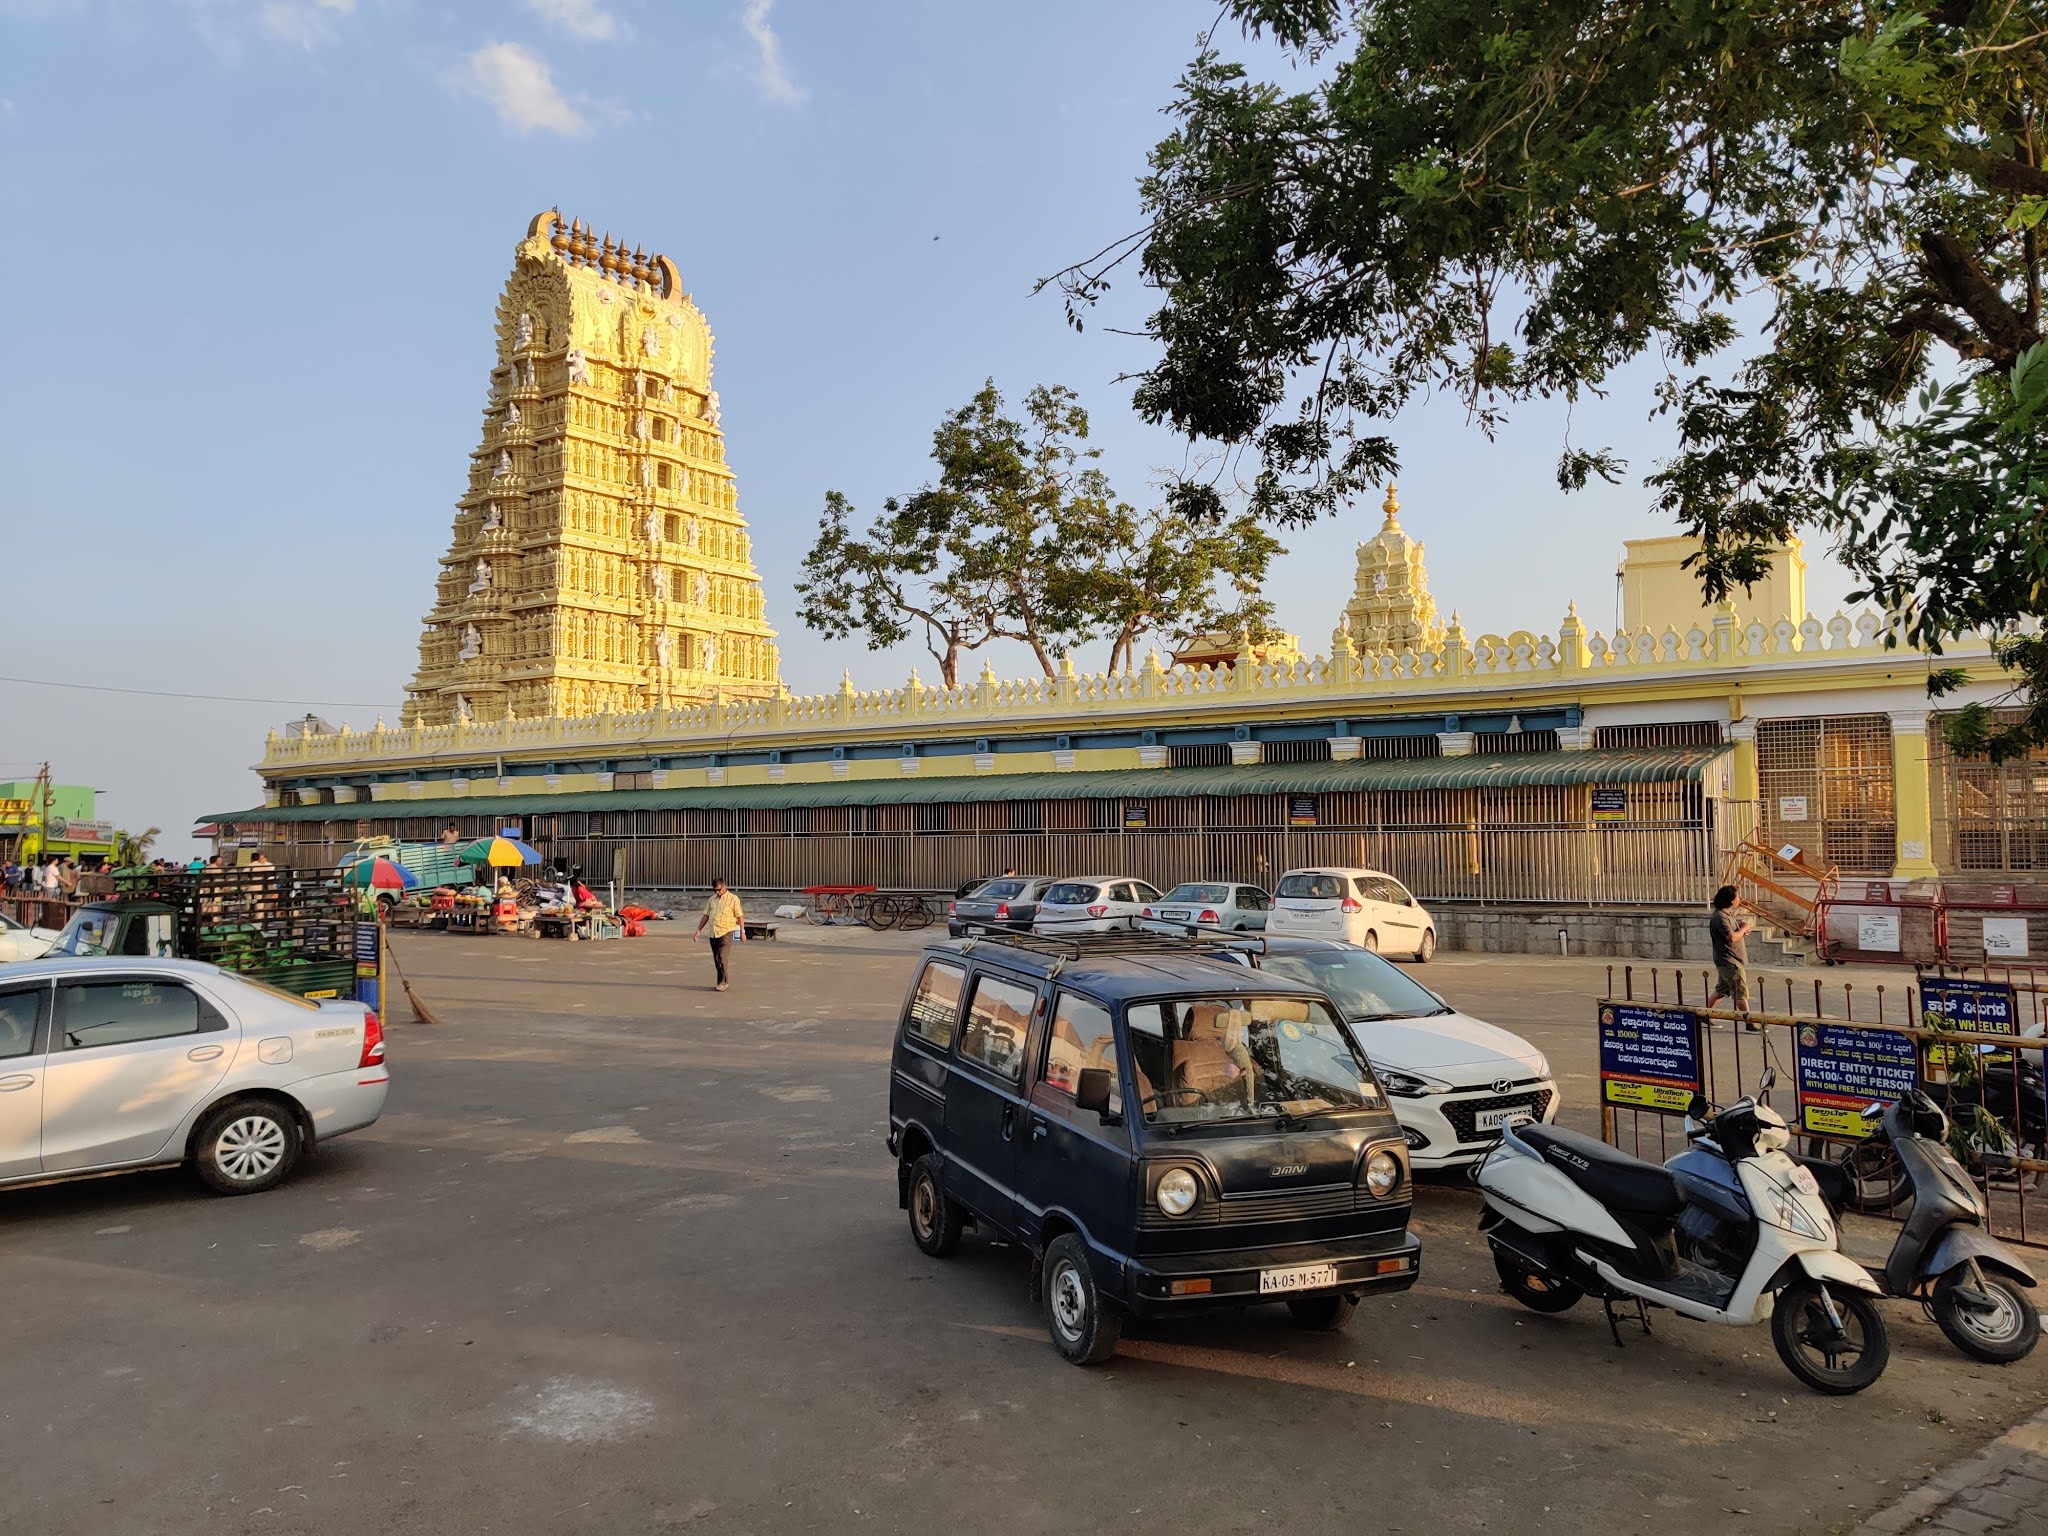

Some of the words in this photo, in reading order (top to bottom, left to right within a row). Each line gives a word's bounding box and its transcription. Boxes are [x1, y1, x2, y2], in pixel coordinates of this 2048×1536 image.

[1664, 1021, 1687, 1031] ವಿನಂತಿ
[1958, 1019, 2011, 1034] WHEELER
[1868, 1040, 1883, 1051] 100/-
[1801, 1057, 1837, 1070] DIRECT
[1840, 1062, 1874, 1075] ENTRY
[1876, 1066, 1915, 1080] TICKET
[1805, 1069, 1843, 1082] Rs.100/-
[1845, 1074, 1867, 1086] ONE
[1870, 1077, 1912, 1091] PERSON
[1653, 1088, 1684, 1097] UltraTech
[1806, 1080, 1822, 1089] WITH
[1824, 1083, 1837, 1091] ONE
[1839, 1085, 1855, 1093] FREE
[1856, 1087, 1878, 1096] LADDU
[1880, 1089, 1902, 1100] PRASA
[1805, 1096, 1868, 1109] www.chamundesh
[1572, 1155, 1590, 1169] TVS
[1272, 1165, 1307, 1176] OMNI
